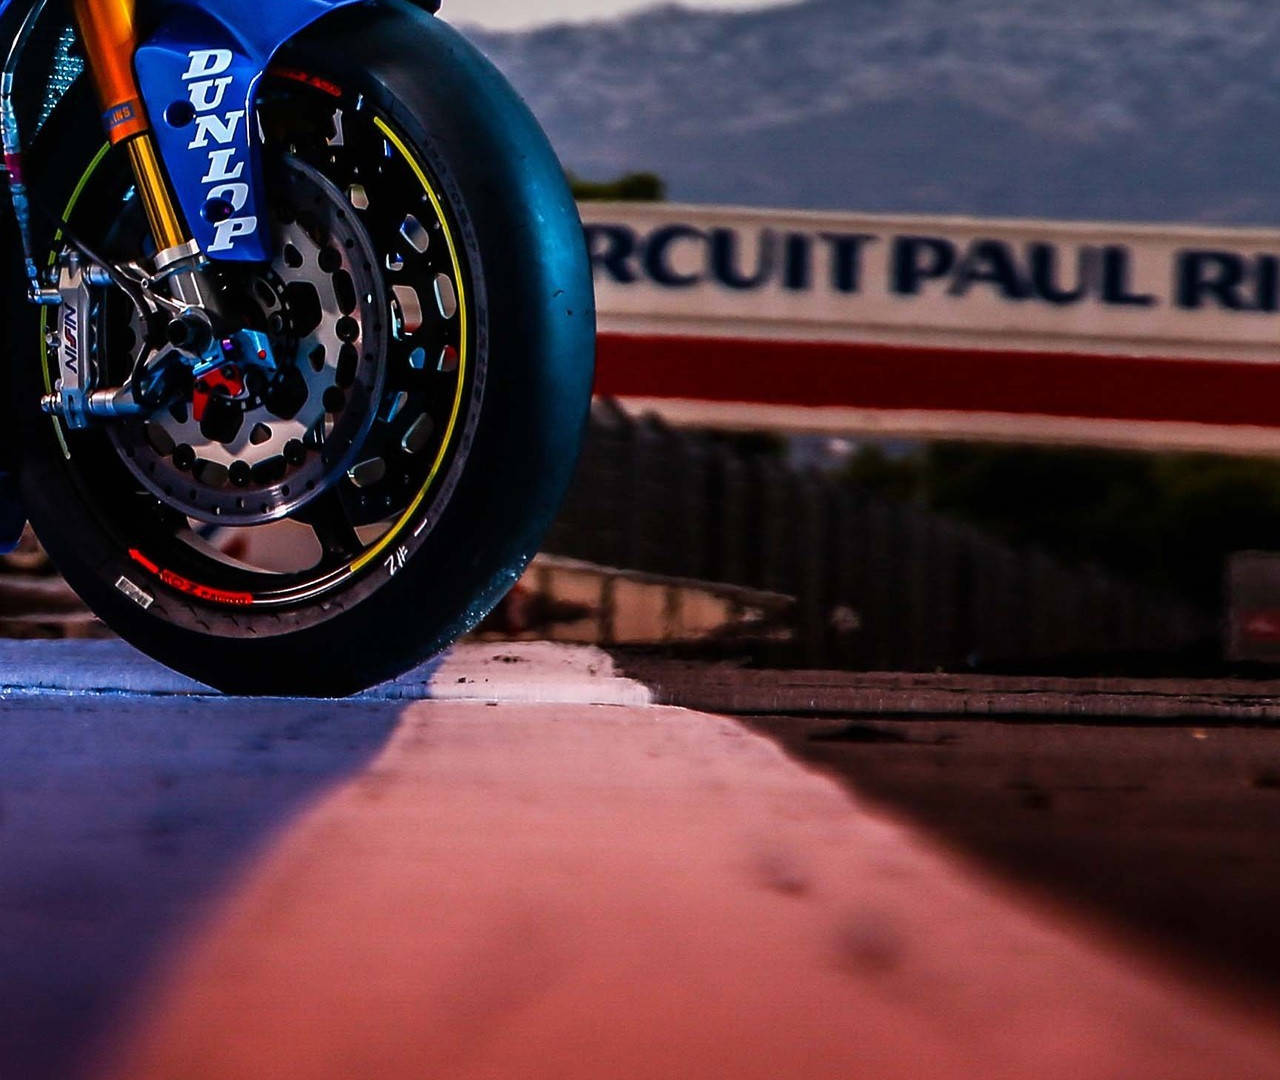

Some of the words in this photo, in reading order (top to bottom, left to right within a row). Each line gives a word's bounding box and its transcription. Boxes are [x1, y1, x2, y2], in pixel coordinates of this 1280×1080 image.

[182, 48, 257, 253] DUNLOP
[582, 222, 881, 294] RCUIT
[891, 234, 1158, 307] PAUL
[1173, 247, 1280, 314] RI
